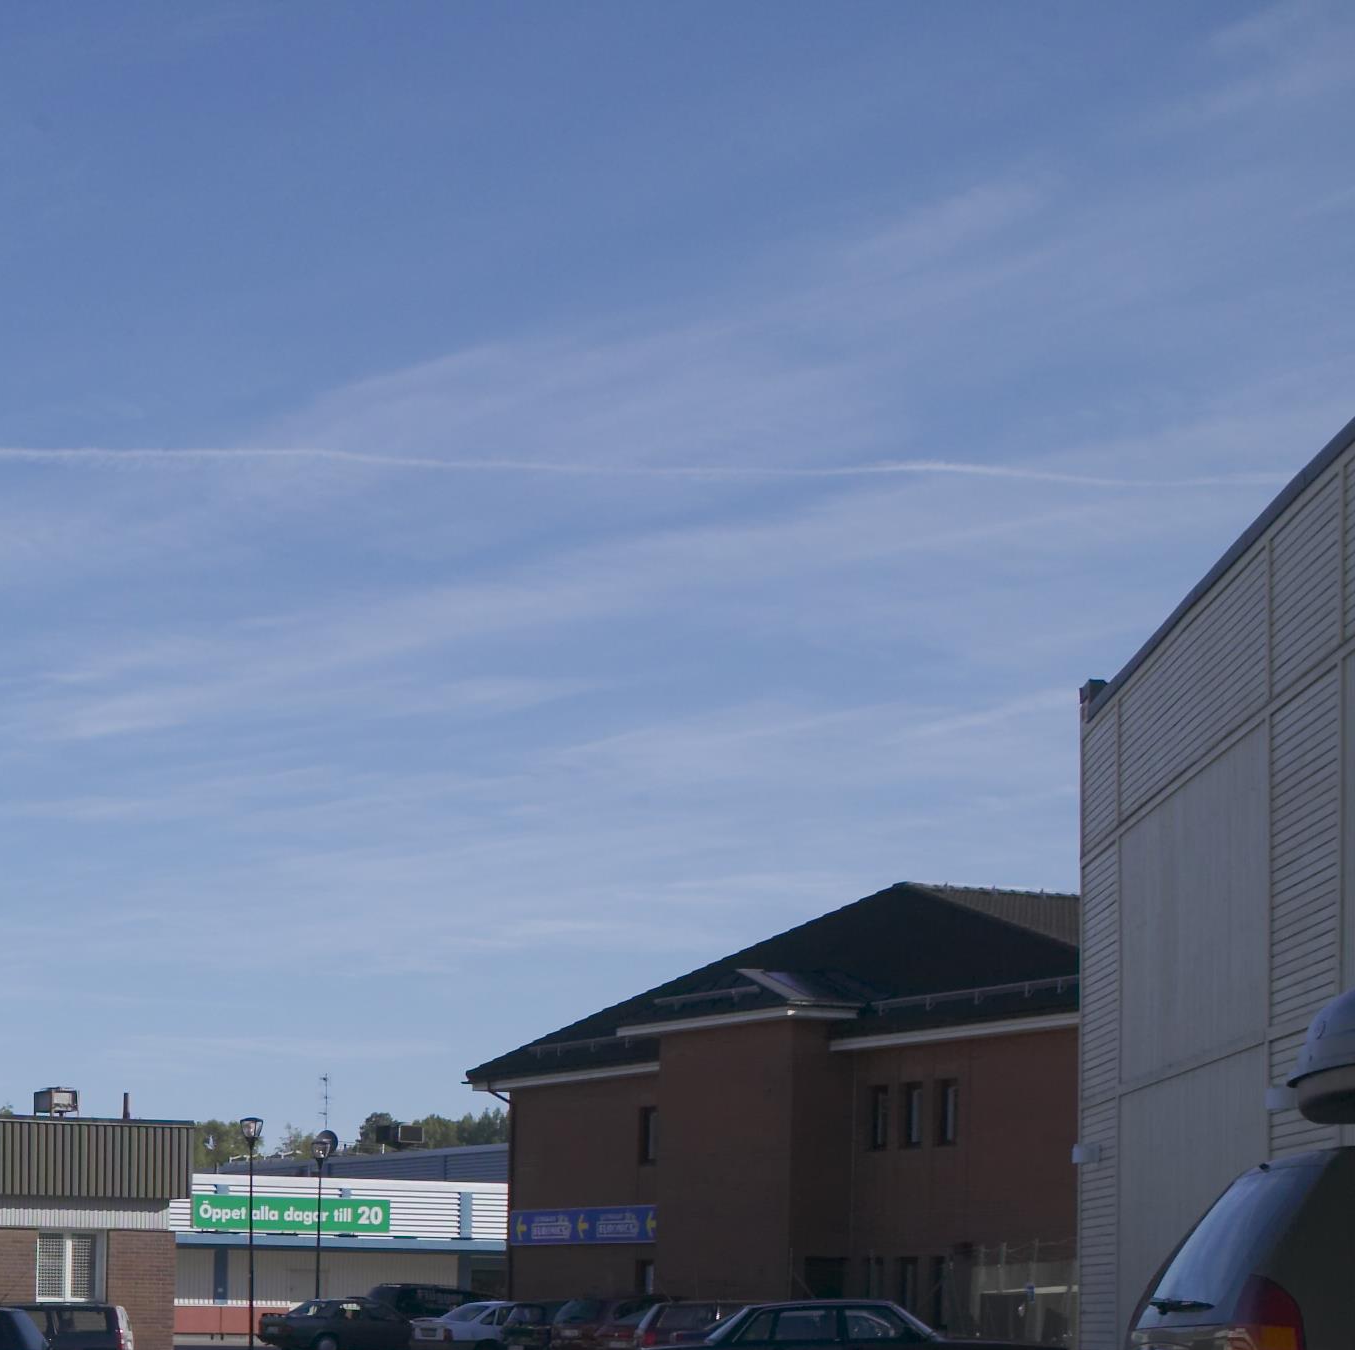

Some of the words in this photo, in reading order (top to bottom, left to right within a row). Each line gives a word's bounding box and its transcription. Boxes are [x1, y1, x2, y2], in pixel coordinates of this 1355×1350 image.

[199, 1200, 247, 1222] Öppet
[252, 1205, 279, 1220] alla
[283, 1206, 329, 1225] dagar
[333, 1207, 352, 1222] till
[357, 1206, 383, 1225] 20
